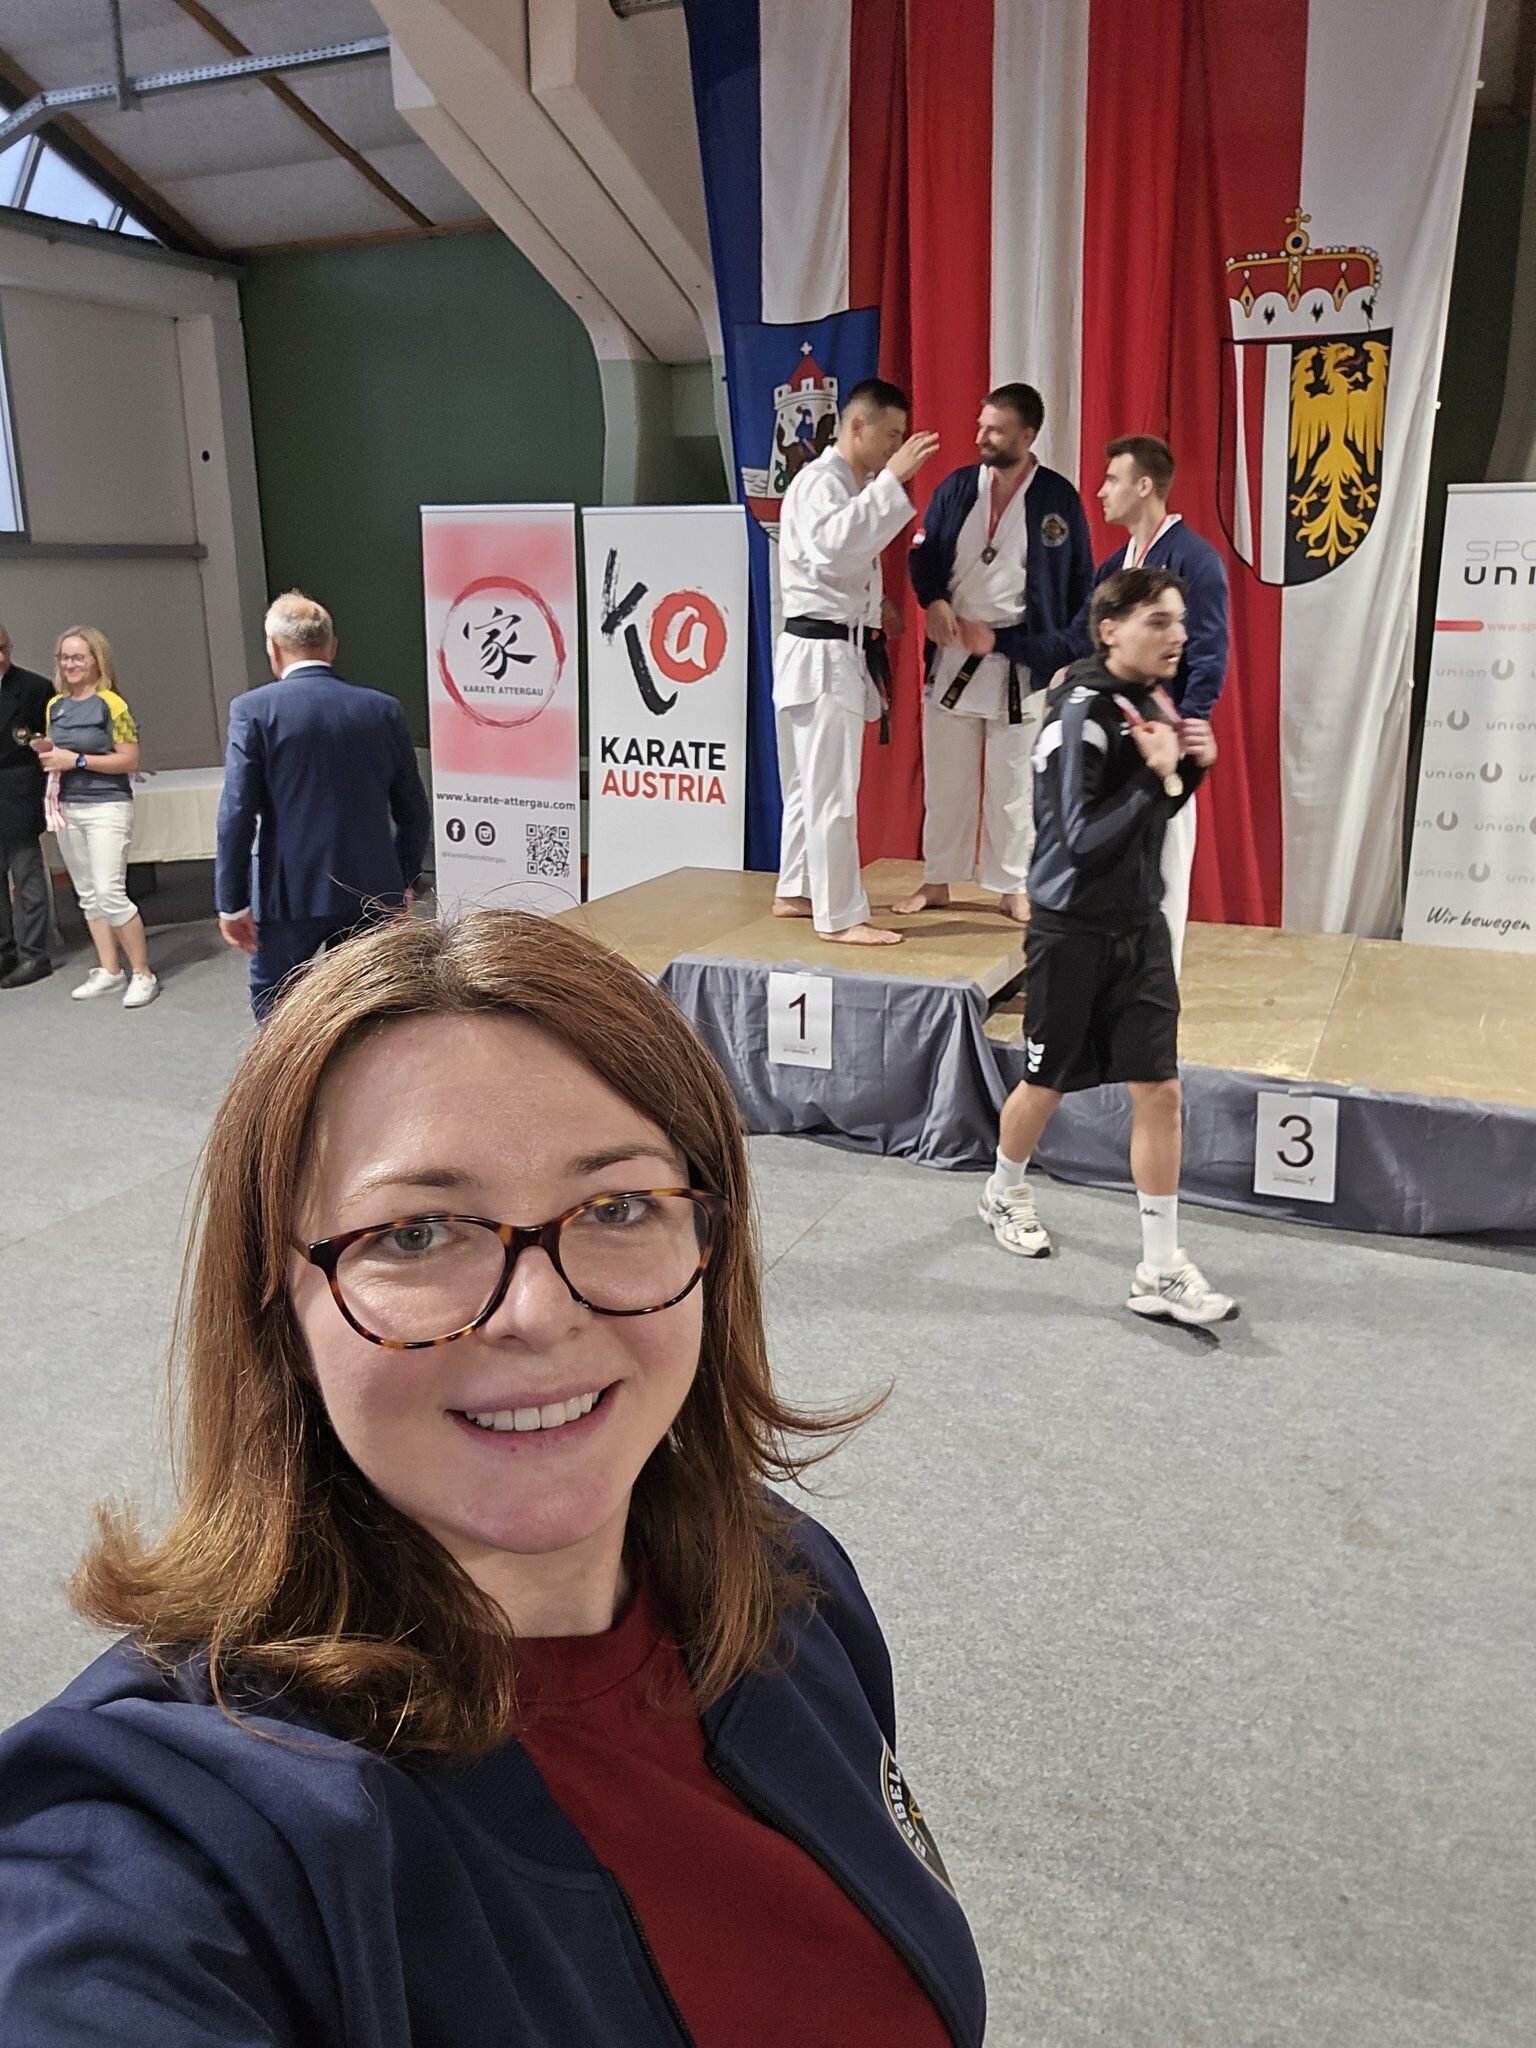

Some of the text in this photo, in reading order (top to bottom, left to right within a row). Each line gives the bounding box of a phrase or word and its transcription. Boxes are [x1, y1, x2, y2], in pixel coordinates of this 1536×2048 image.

[463, 606, 537, 680] 家
[463, 685, 544, 697] KARATE ATTERGAU
[601, 735, 727, 772] KARATE
[436, 792, 576, 811] www.karate-attergau.com
[601, 769, 728, 805] AUSTRIA
[1427, 906, 1531, 936] Wir bewegen
[788, 993, 806, 1040] 1
[1276, 1114, 1315, 1168] 3
